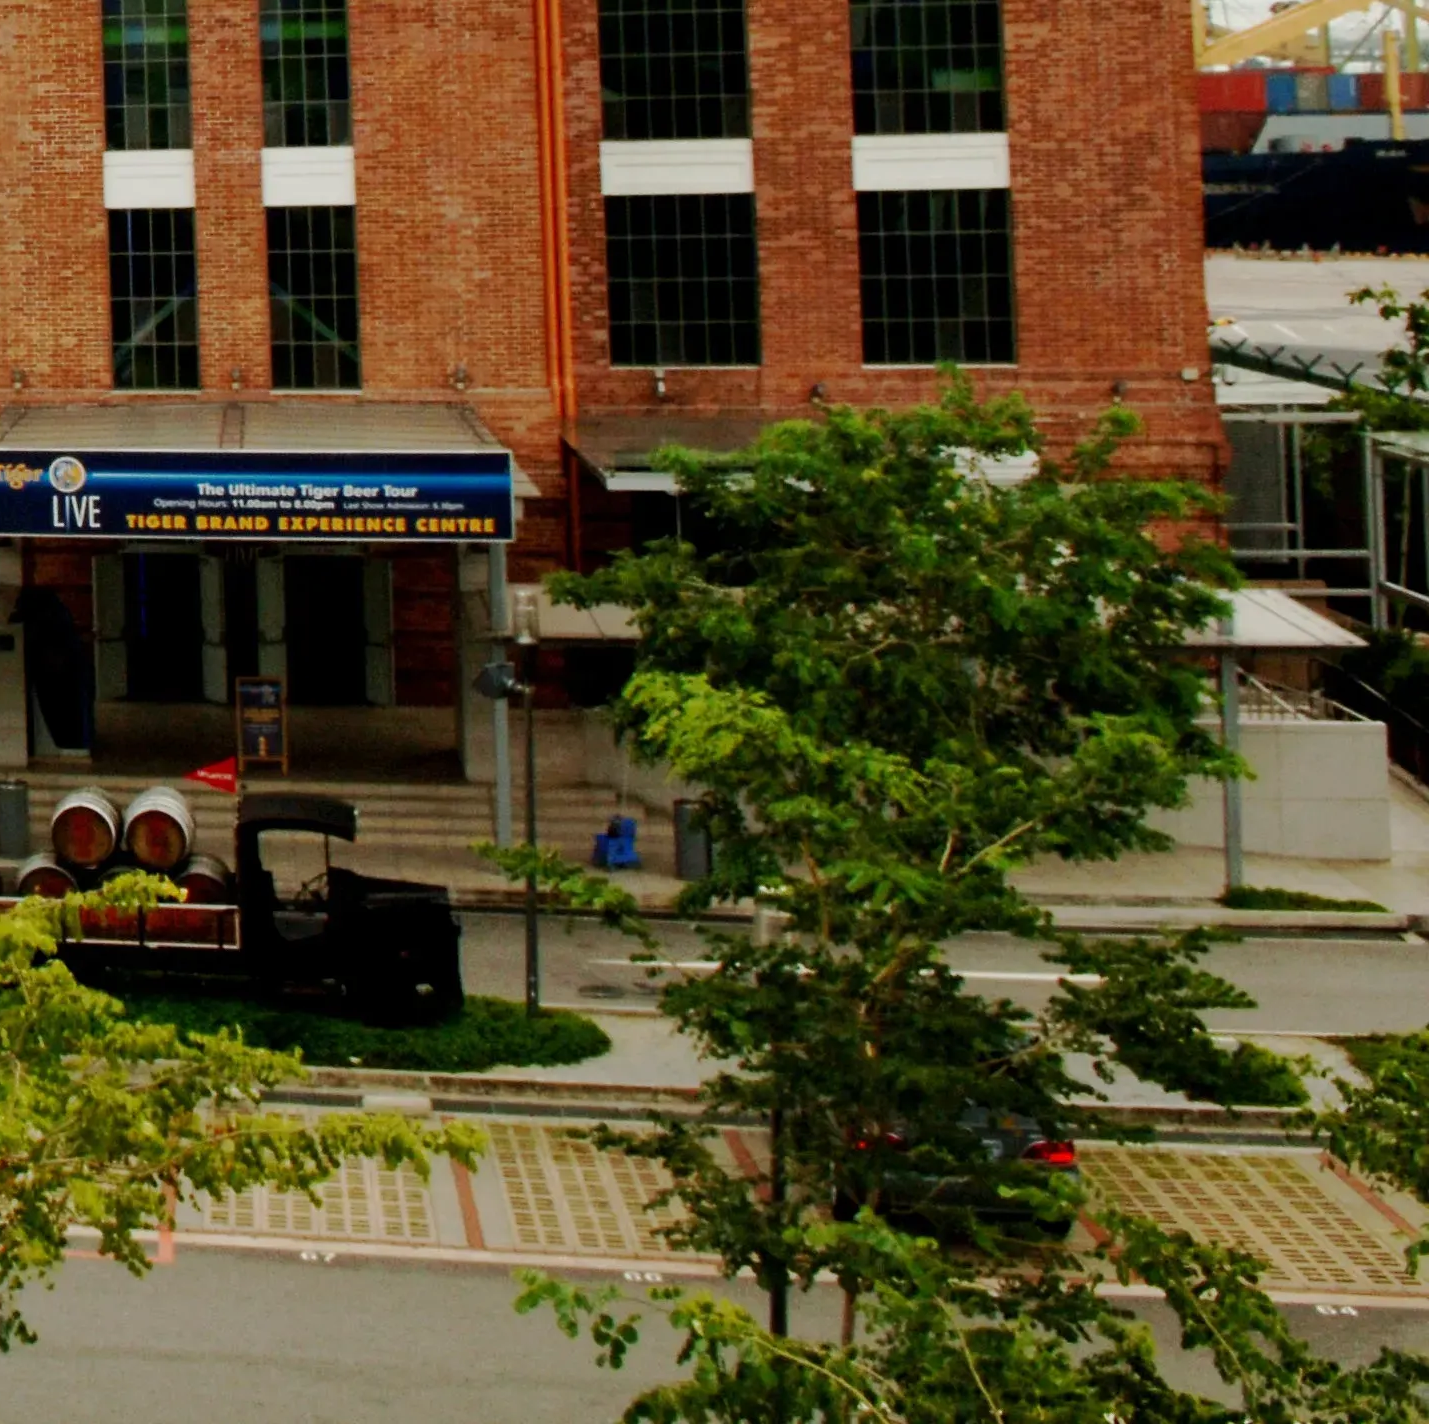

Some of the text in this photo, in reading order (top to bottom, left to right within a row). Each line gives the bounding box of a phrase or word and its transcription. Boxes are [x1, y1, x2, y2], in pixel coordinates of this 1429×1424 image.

[197, 483, 417, 499] The Ultimate Tiger Beer Tour
[52, 495, 99, 528] LIVE
[153, 498, 196, 509] Opening
[279, 500, 292, 508] to
[125, 515, 495, 533] TIGER BRAND EXPERIENCE CENTRE
